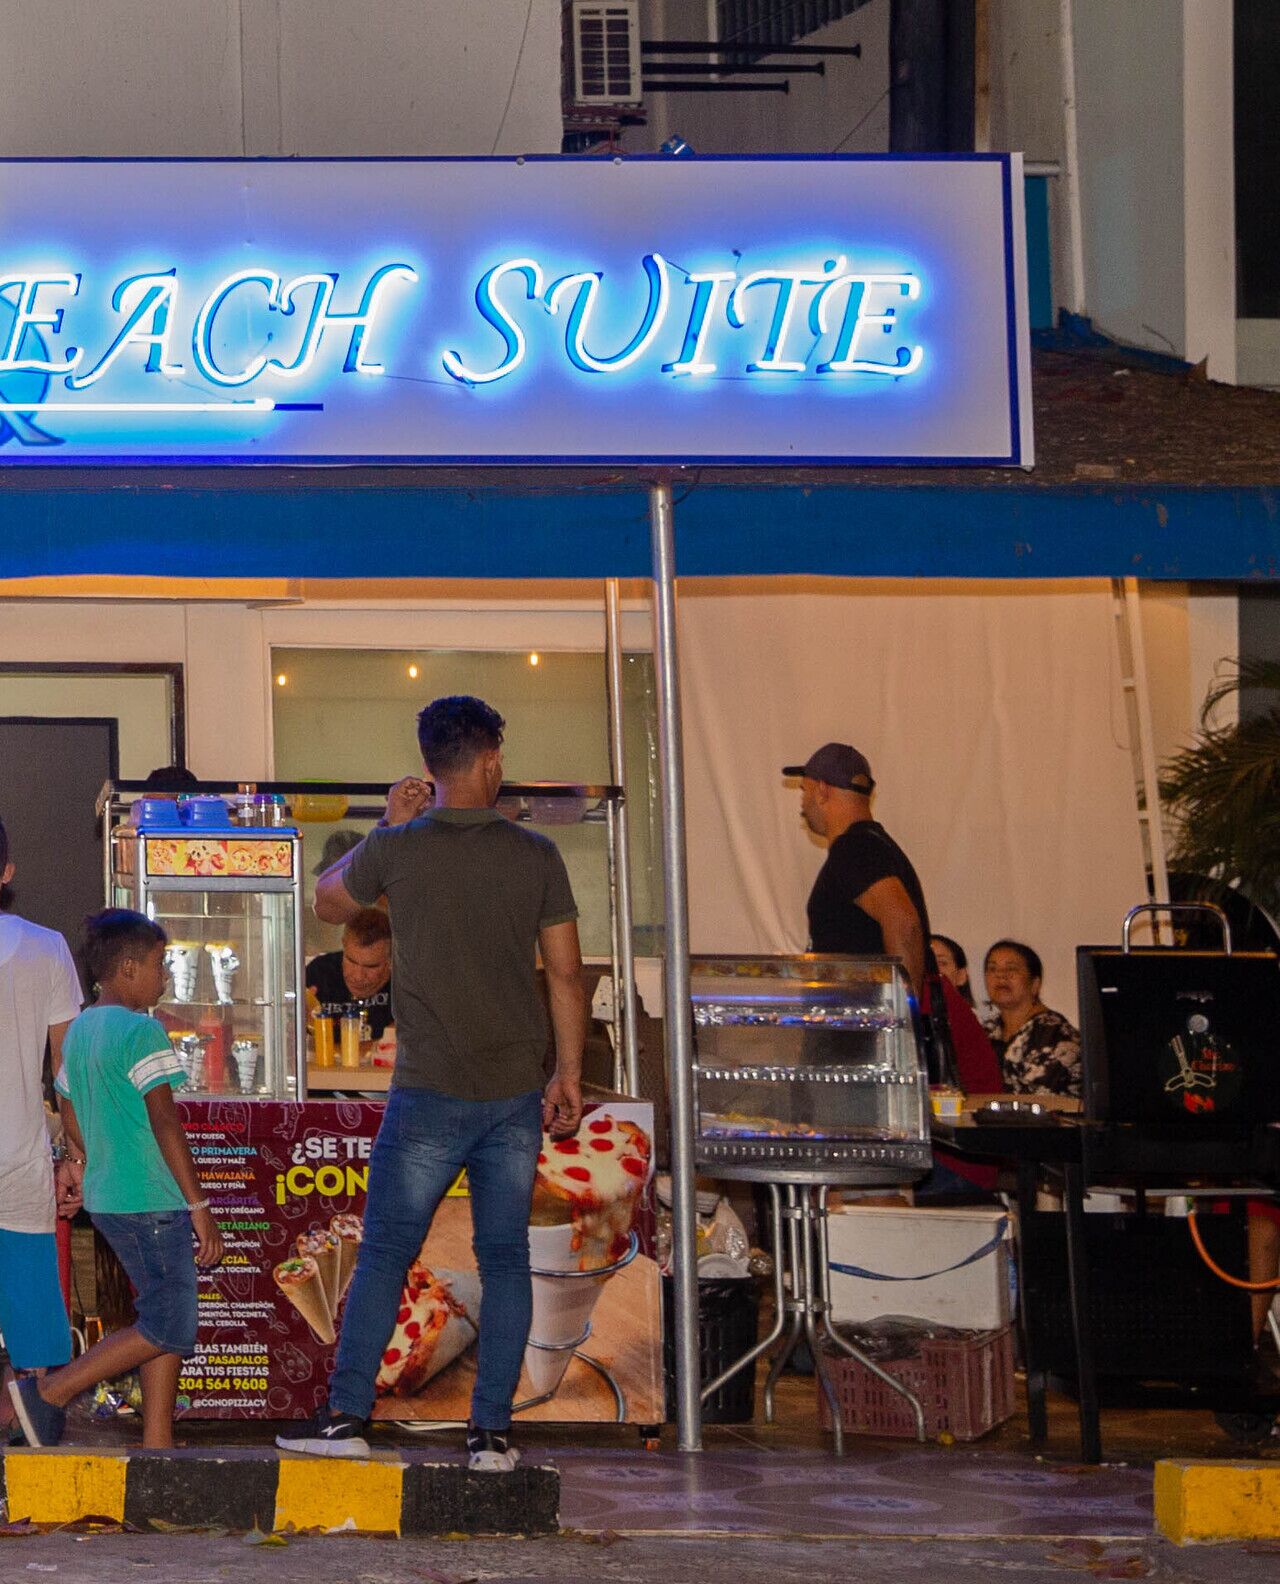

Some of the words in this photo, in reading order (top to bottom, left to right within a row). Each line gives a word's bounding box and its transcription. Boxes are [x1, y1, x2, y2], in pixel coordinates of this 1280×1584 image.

[441, 254, 925, 385] SUITE
[201, 1146, 257, 1156] PRIMAVERA
[291, 1137, 338, 1164] ¿SE
[201, 1171, 256, 1181] HAWAIANA
[230, 1205, 265, 1214] ORÉGANO
[193, 1344, 219, 1354] ELAS
[220, 1341, 268, 1354] TAMBIÉN
[207, 1354, 269, 1365] PASAPALOS
[180, 1366, 204, 1376] ARA
[205, 1366, 225, 1376] TUS
[226, 1366, 270, 1376] FIESTAS
[178, 1377, 204, 1390] 304
[205, 1377, 231, 1390] 564
[233, 1377, 268, 1390] 9608
